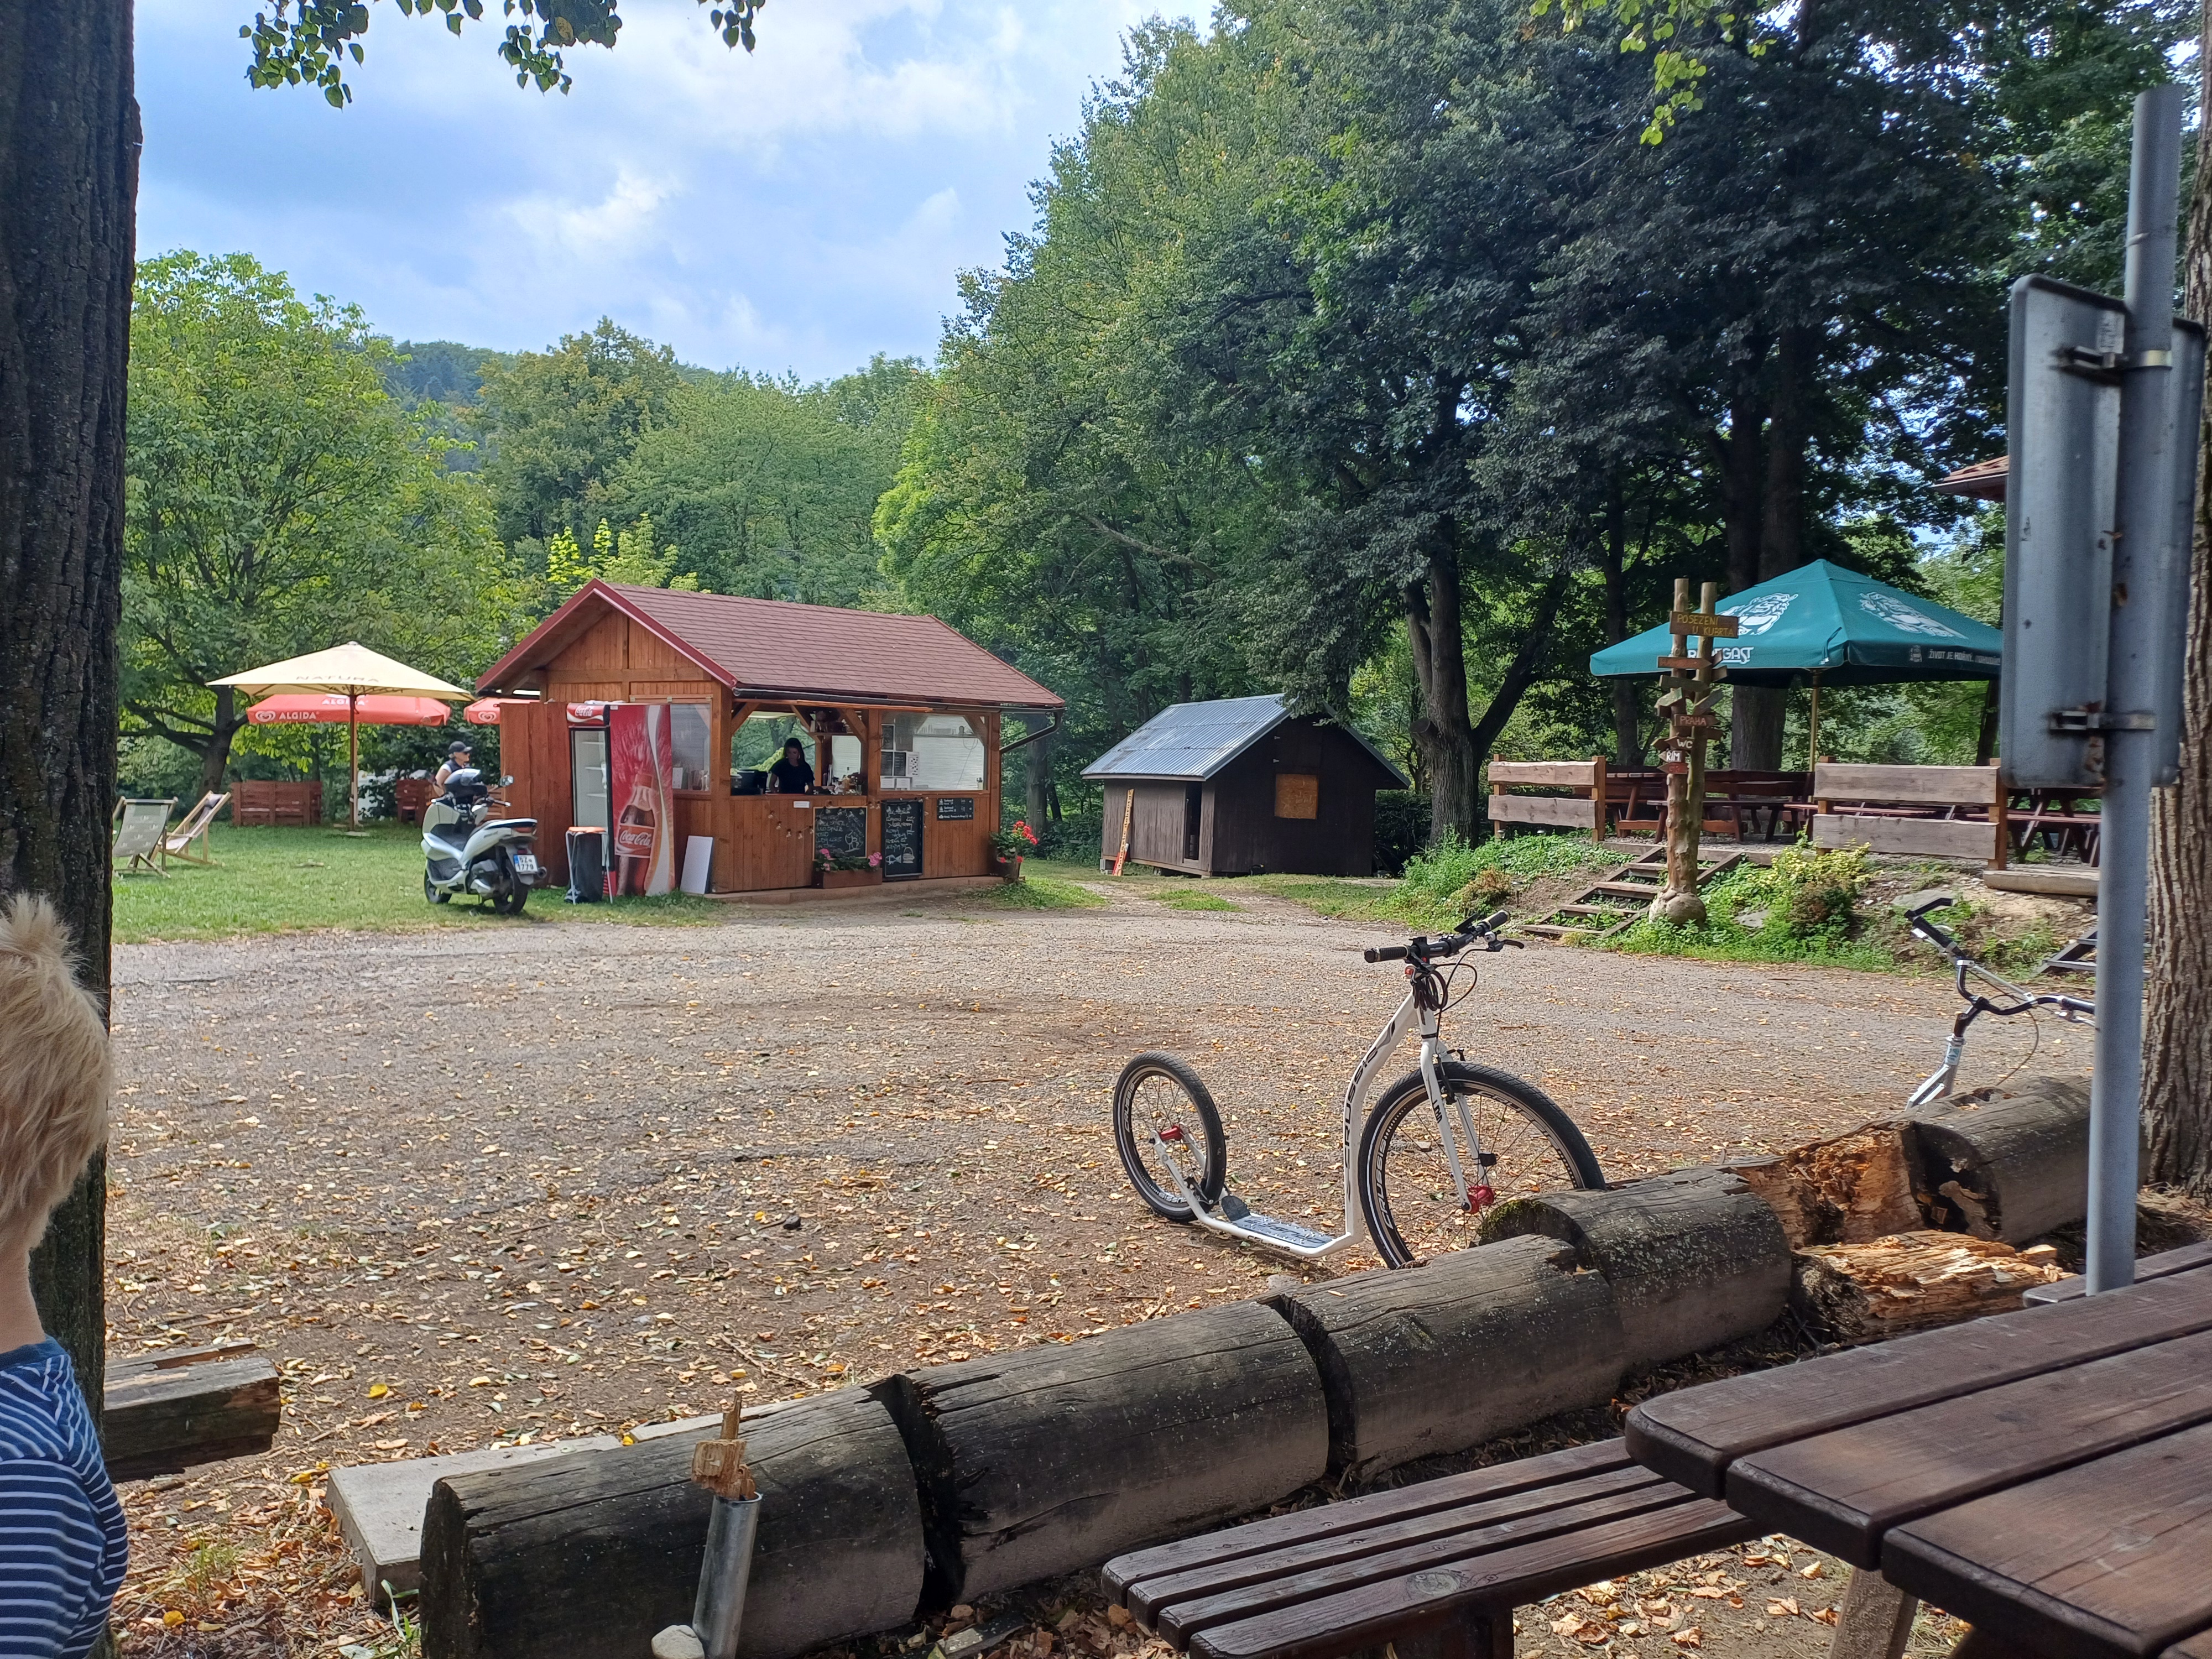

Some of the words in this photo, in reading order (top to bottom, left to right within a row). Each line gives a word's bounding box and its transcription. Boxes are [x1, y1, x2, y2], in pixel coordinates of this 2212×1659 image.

[1703, 627, 1734, 635] KUBRTA
[1946, 651, 1954, 660] JE
[1679, 716, 1707, 725] PRAHA
[1676, 739, 1693, 749] WC
[1124, 1083, 1135, 1133] CRUSSIS
[1345, 1047, 1378, 1170] CRUSSIS
[1376, 1138, 1394, 1229] CRUSSIS
